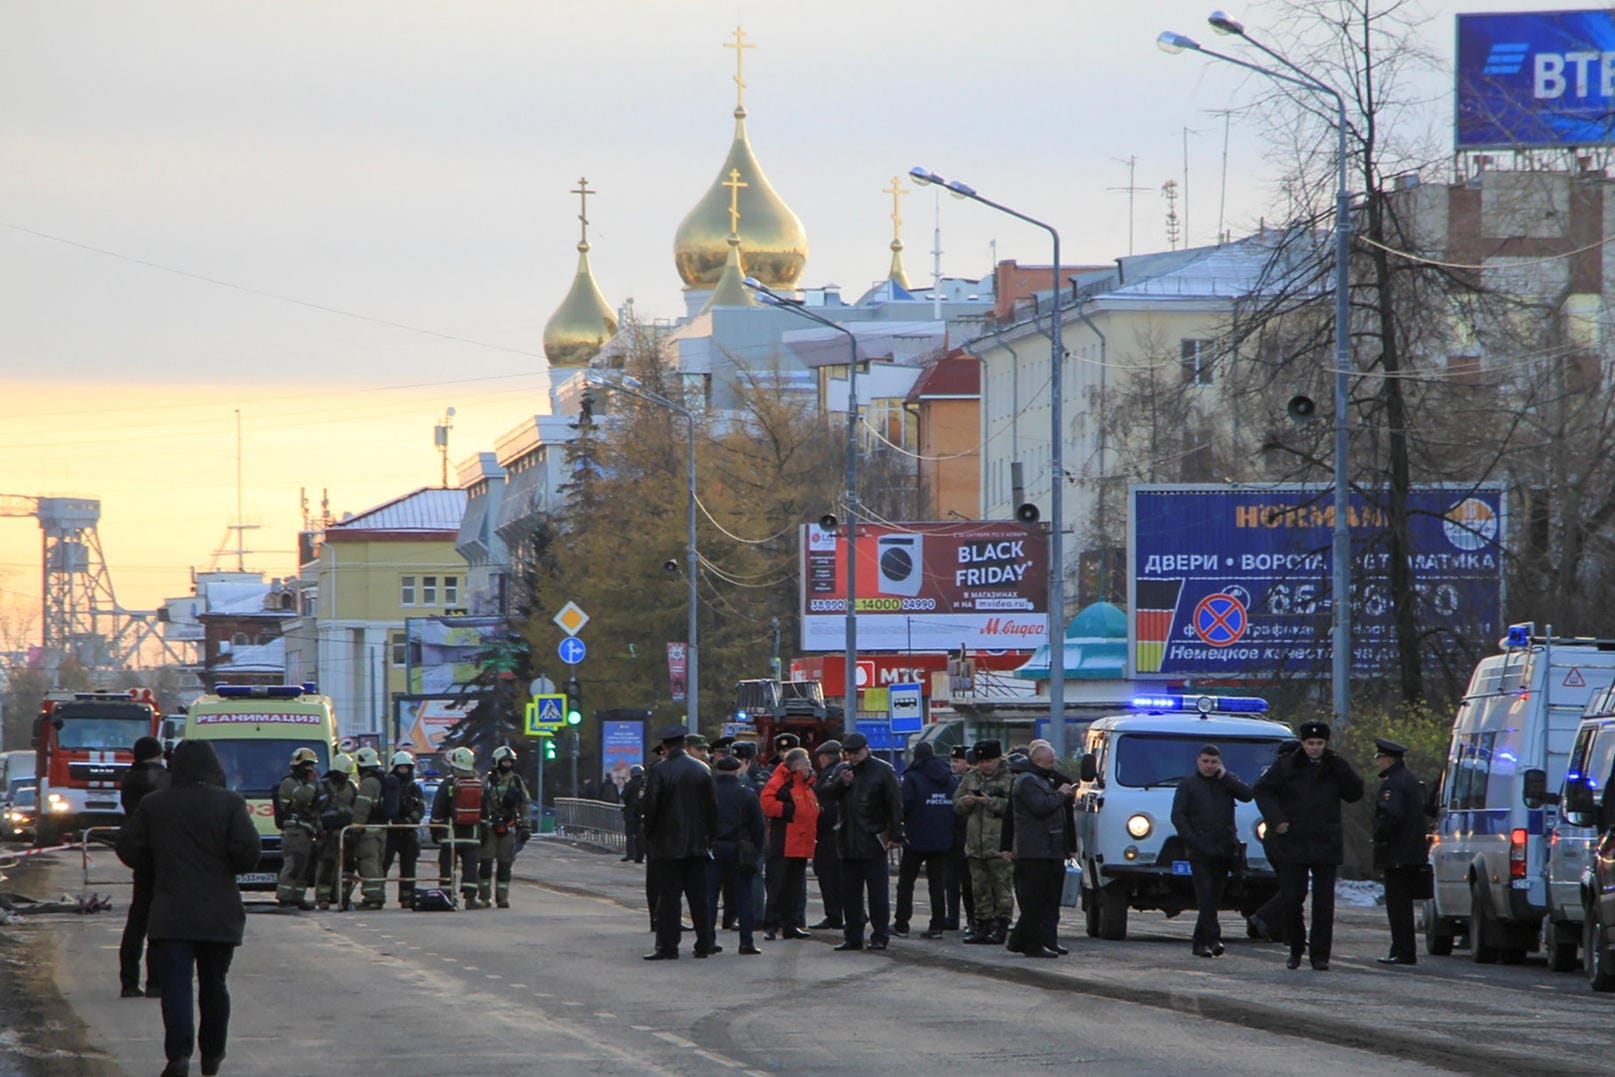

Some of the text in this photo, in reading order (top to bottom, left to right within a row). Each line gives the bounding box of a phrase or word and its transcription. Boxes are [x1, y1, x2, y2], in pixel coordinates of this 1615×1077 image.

[957, 540, 1024, 563] BLACK
[1145, 555, 1218, 573] ДВЕРИ
[812, 599, 845, 611] 38990
[861, 599, 899, 610] 14000
[902, 599, 935, 610] 24990
[979, 600, 1024, 608] mvideo.ru
[1169, 646, 1259, 662] Немецкое
[880, 668, 926, 683] МТС
[196, 714, 320, 723] РЕАНИМАЦИЯ
